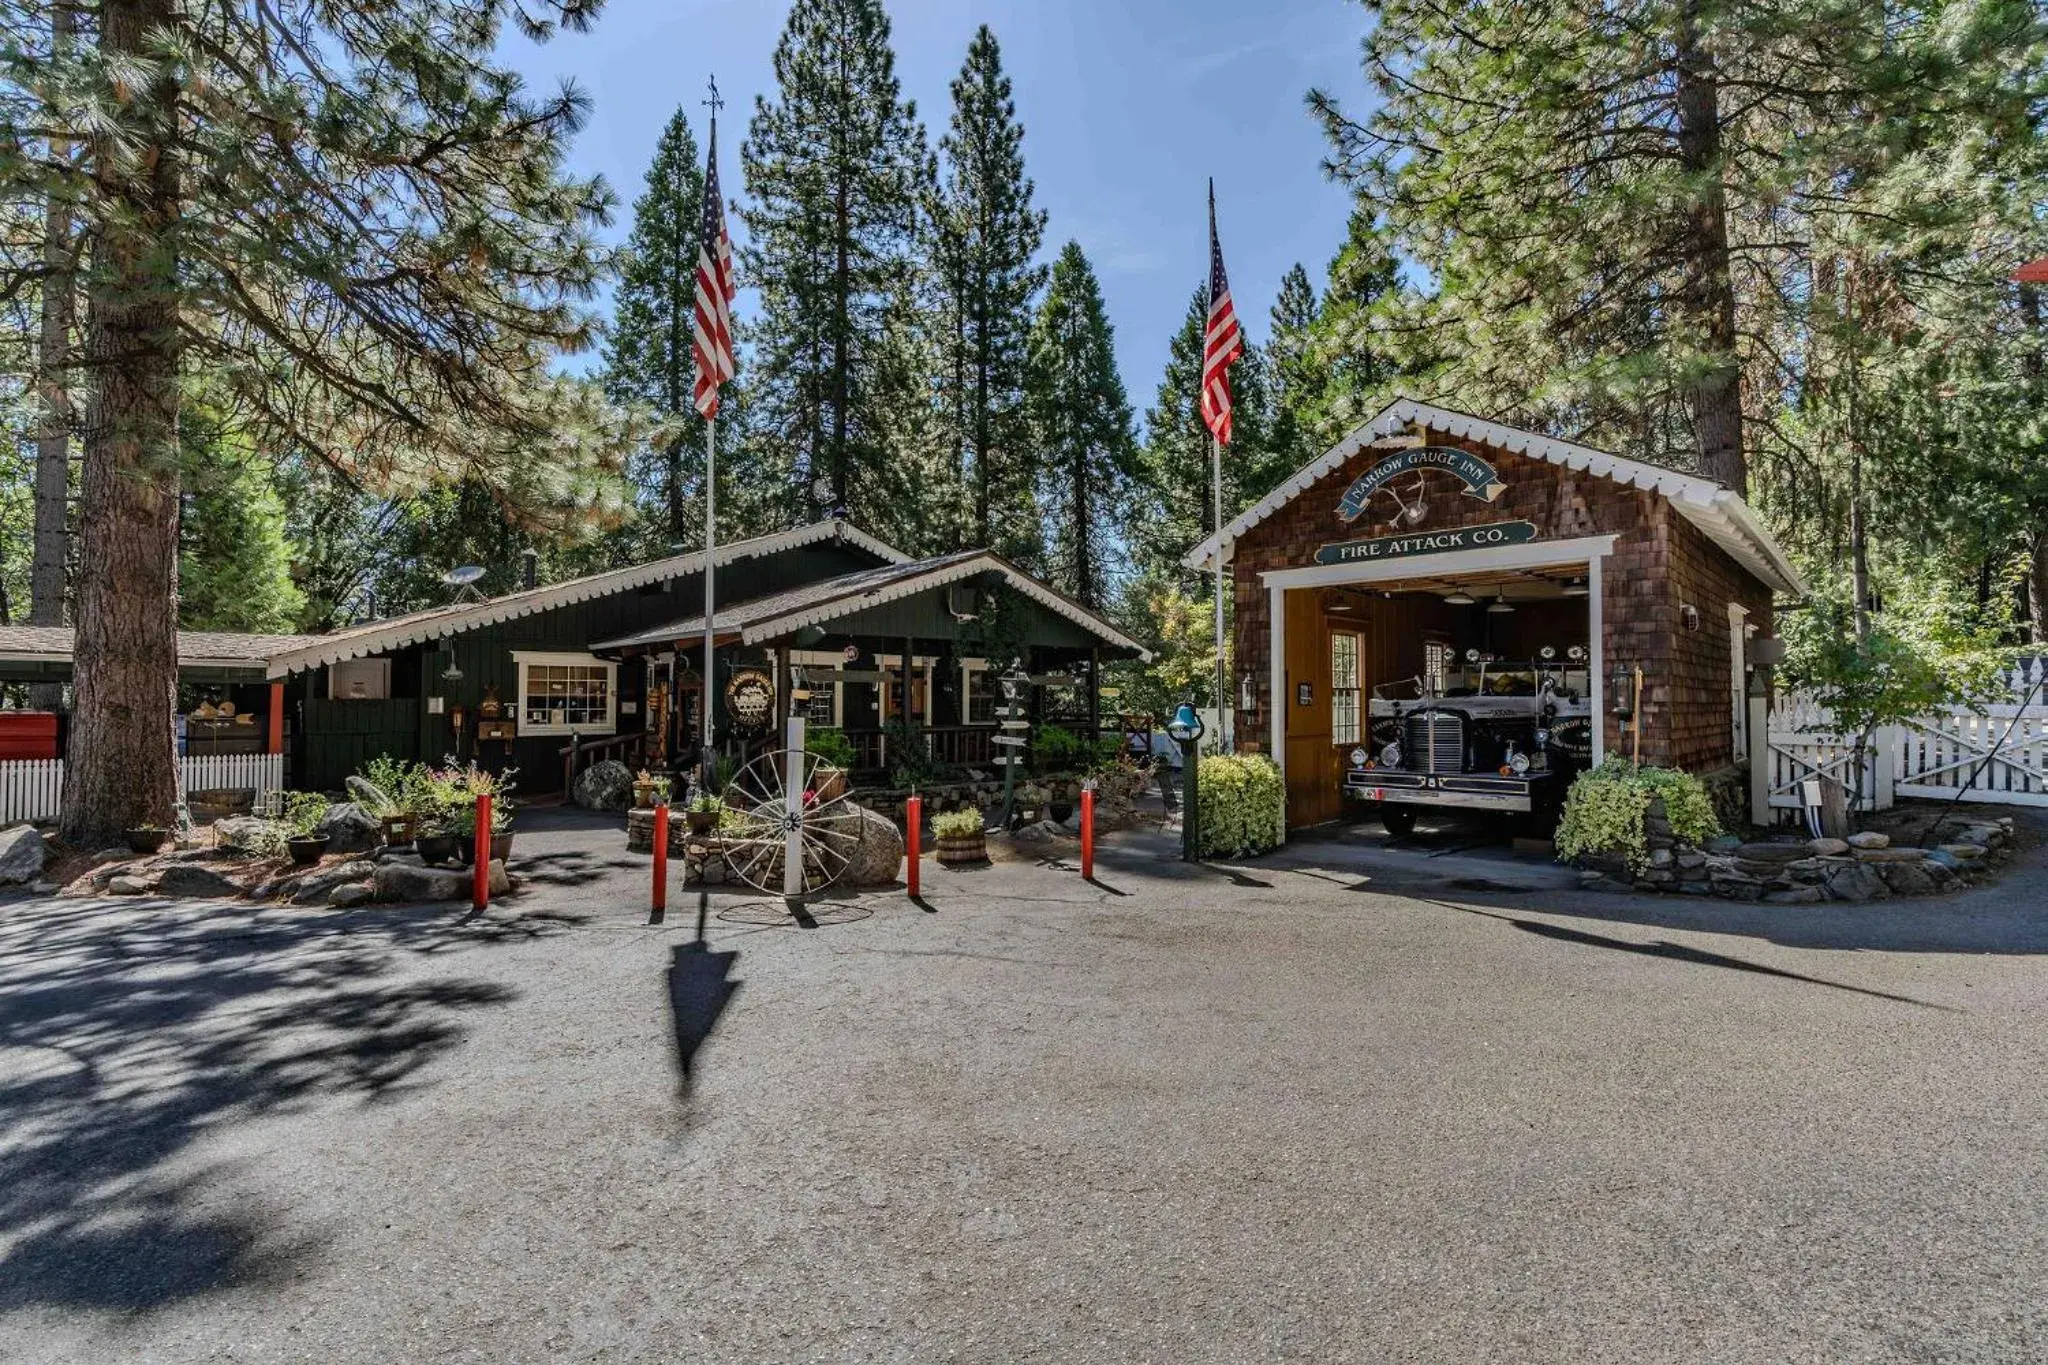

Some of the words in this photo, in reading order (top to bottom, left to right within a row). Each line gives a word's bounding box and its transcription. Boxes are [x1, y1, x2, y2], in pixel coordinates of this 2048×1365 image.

[1351, 458, 1402, 499] NARROW
[1408, 452, 1459, 466] GAUGE
[1459, 460, 1485, 480] INN
[1340, 543, 1381, 559] FIRE
[1388, 532, 1464, 554] ATTACK
[1472, 528, 1509, 544] CO.
